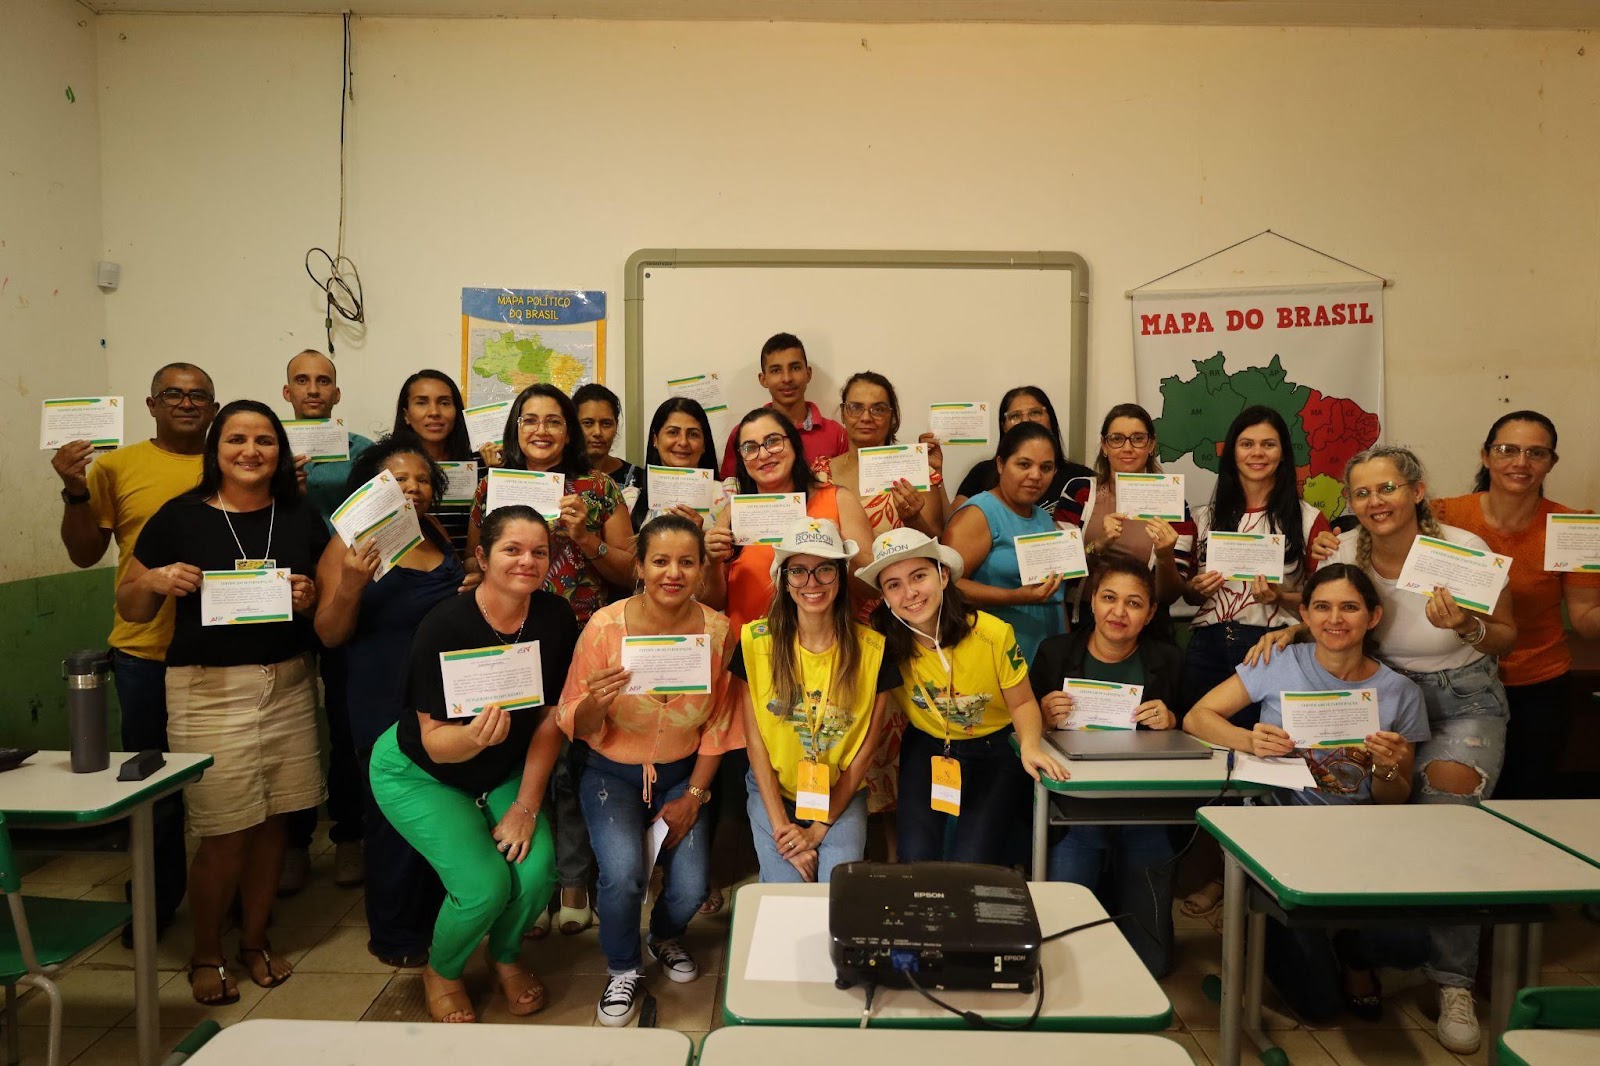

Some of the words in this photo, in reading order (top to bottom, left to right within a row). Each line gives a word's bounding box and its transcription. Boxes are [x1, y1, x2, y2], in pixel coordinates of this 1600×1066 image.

[497, 295, 524, 305] MAPA
[526, 294, 571, 308] POLÍTICO
[509, 309, 523, 319] DO
[525, 309, 559, 320] BRASIL
[1141, 311, 1214, 336] MAPA
[1225, 308, 1263, 332] DO
[1276, 302, 1373, 329] BRASIL
[1190, 408, 1202, 416] AM
[1292, 443, 1303, 451] TO
[1201, 454, 1213, 462] RO
[1313, 500, 1325, 508] MG
